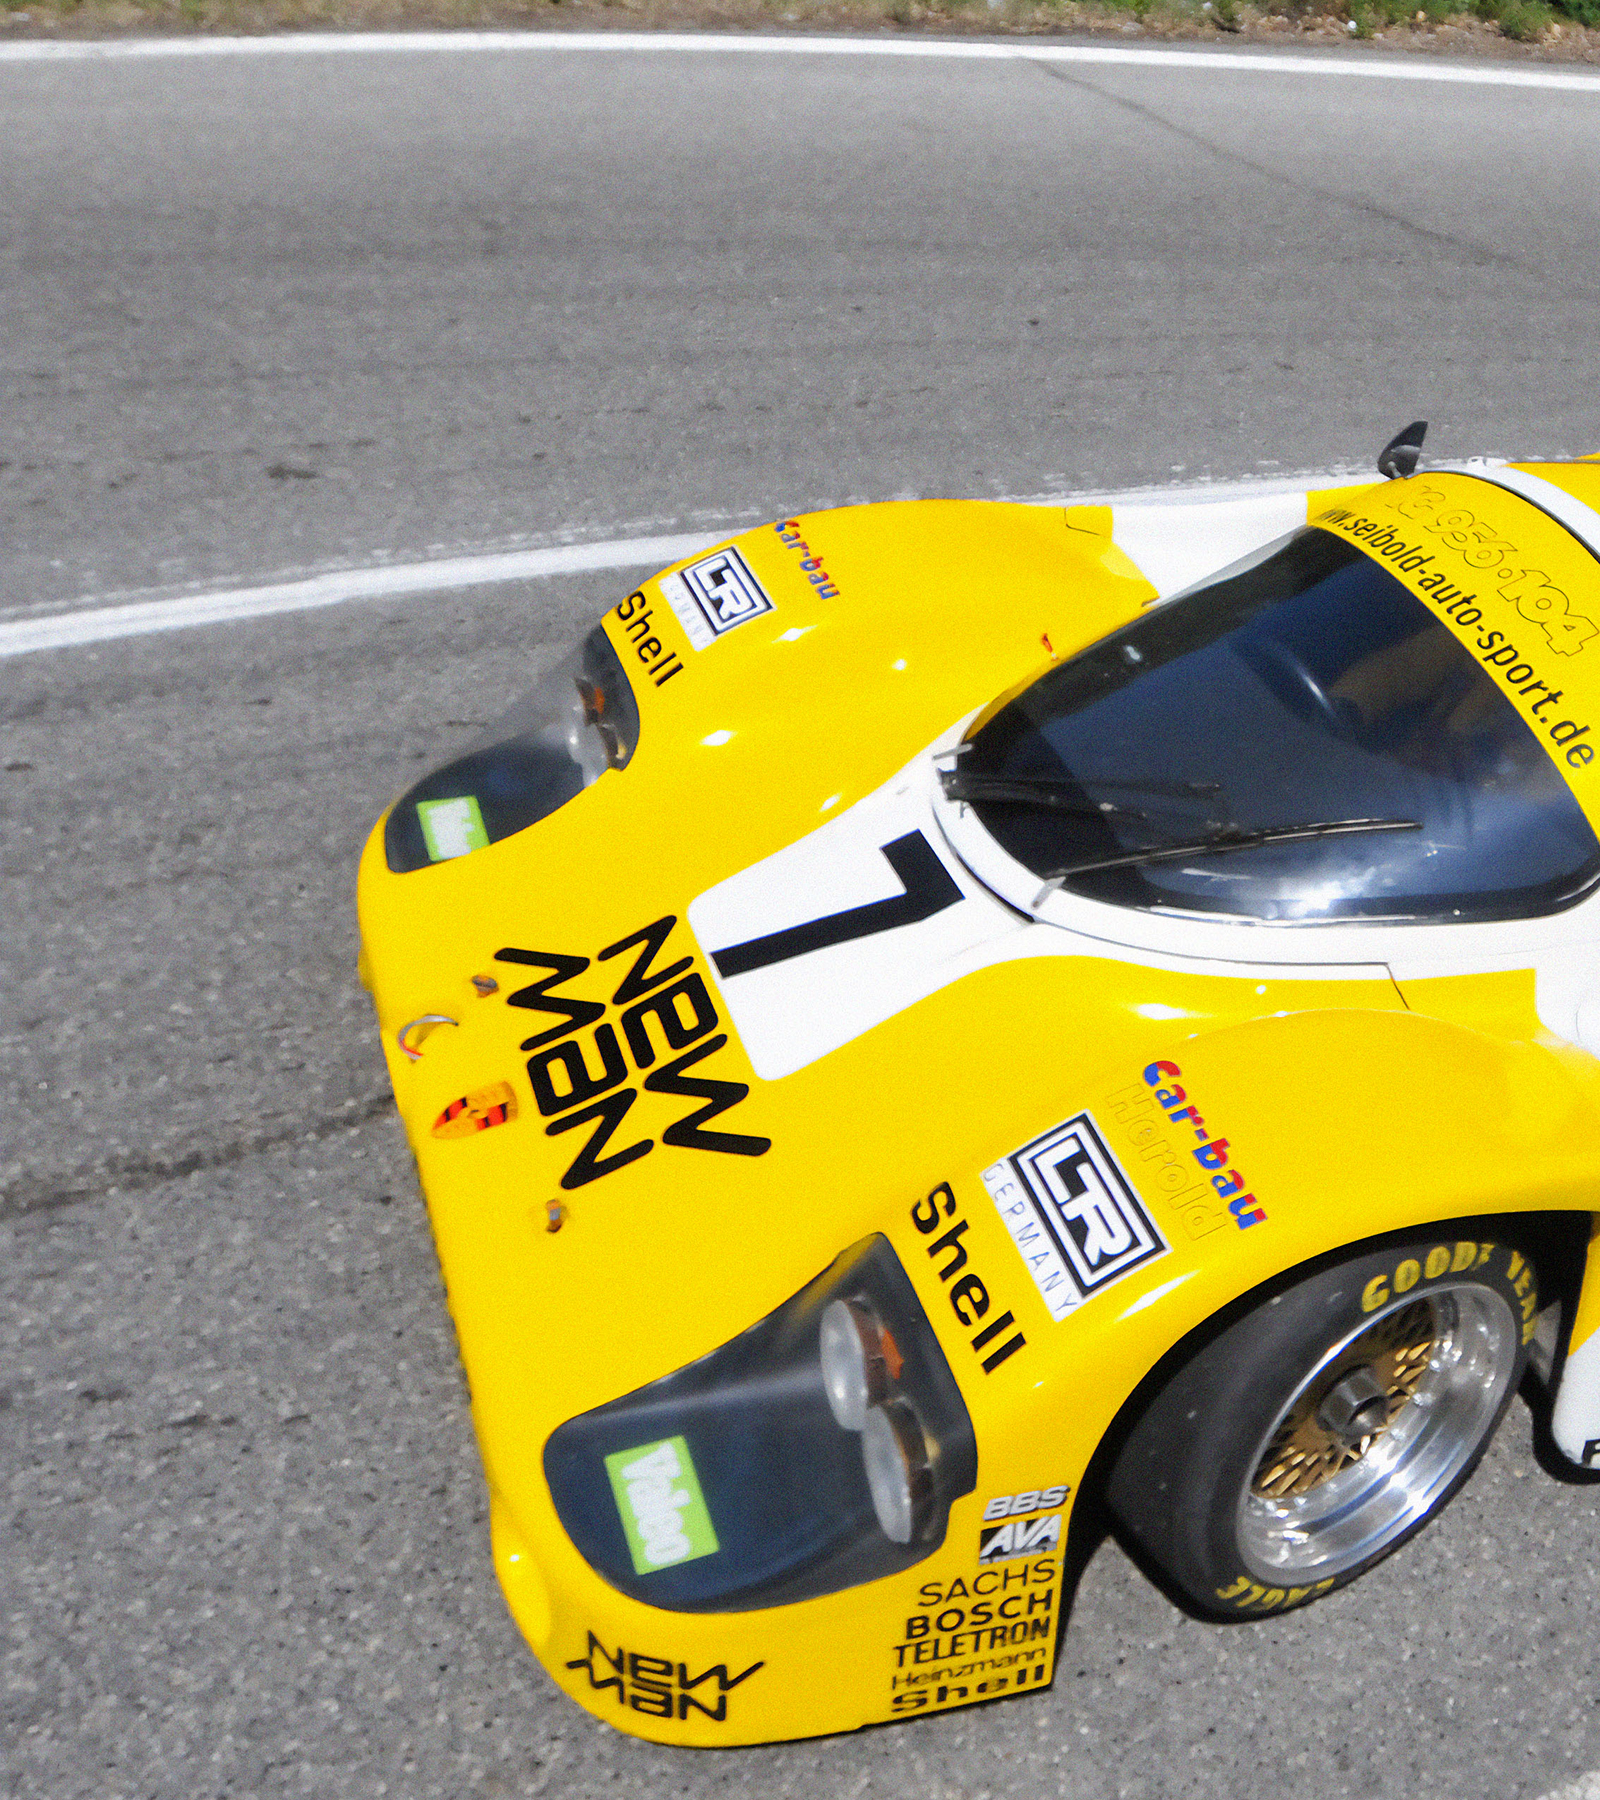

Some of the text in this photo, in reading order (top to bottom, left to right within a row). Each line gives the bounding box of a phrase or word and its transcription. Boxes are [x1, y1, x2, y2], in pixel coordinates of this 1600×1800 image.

[774, 520, 841, 600] Car-bau
[616, 590, 685, 687] Shell
[710, 829, 966, 979] 7
[1107, 1083, 1228, 1242] Herold
[1143, 1060, 1268, 1230] Car-bau
[983, 1163, 1078, 1314] GERMANY
[910, 1181, 1027, 1376] Shell
[983, 1485, 1071, 1521] BBS
[979, 1514, 1062, 1559] AVA
[906, 1589, 1053, 1640] BOSCH
[918, 1559, 1055, 1607] SACHS
[891, 1647, 1047, 1690] Heinzmann
[893, 1616, 1050, 1668] TELETRON
[890, 1664, 1045, 1713] Shell
